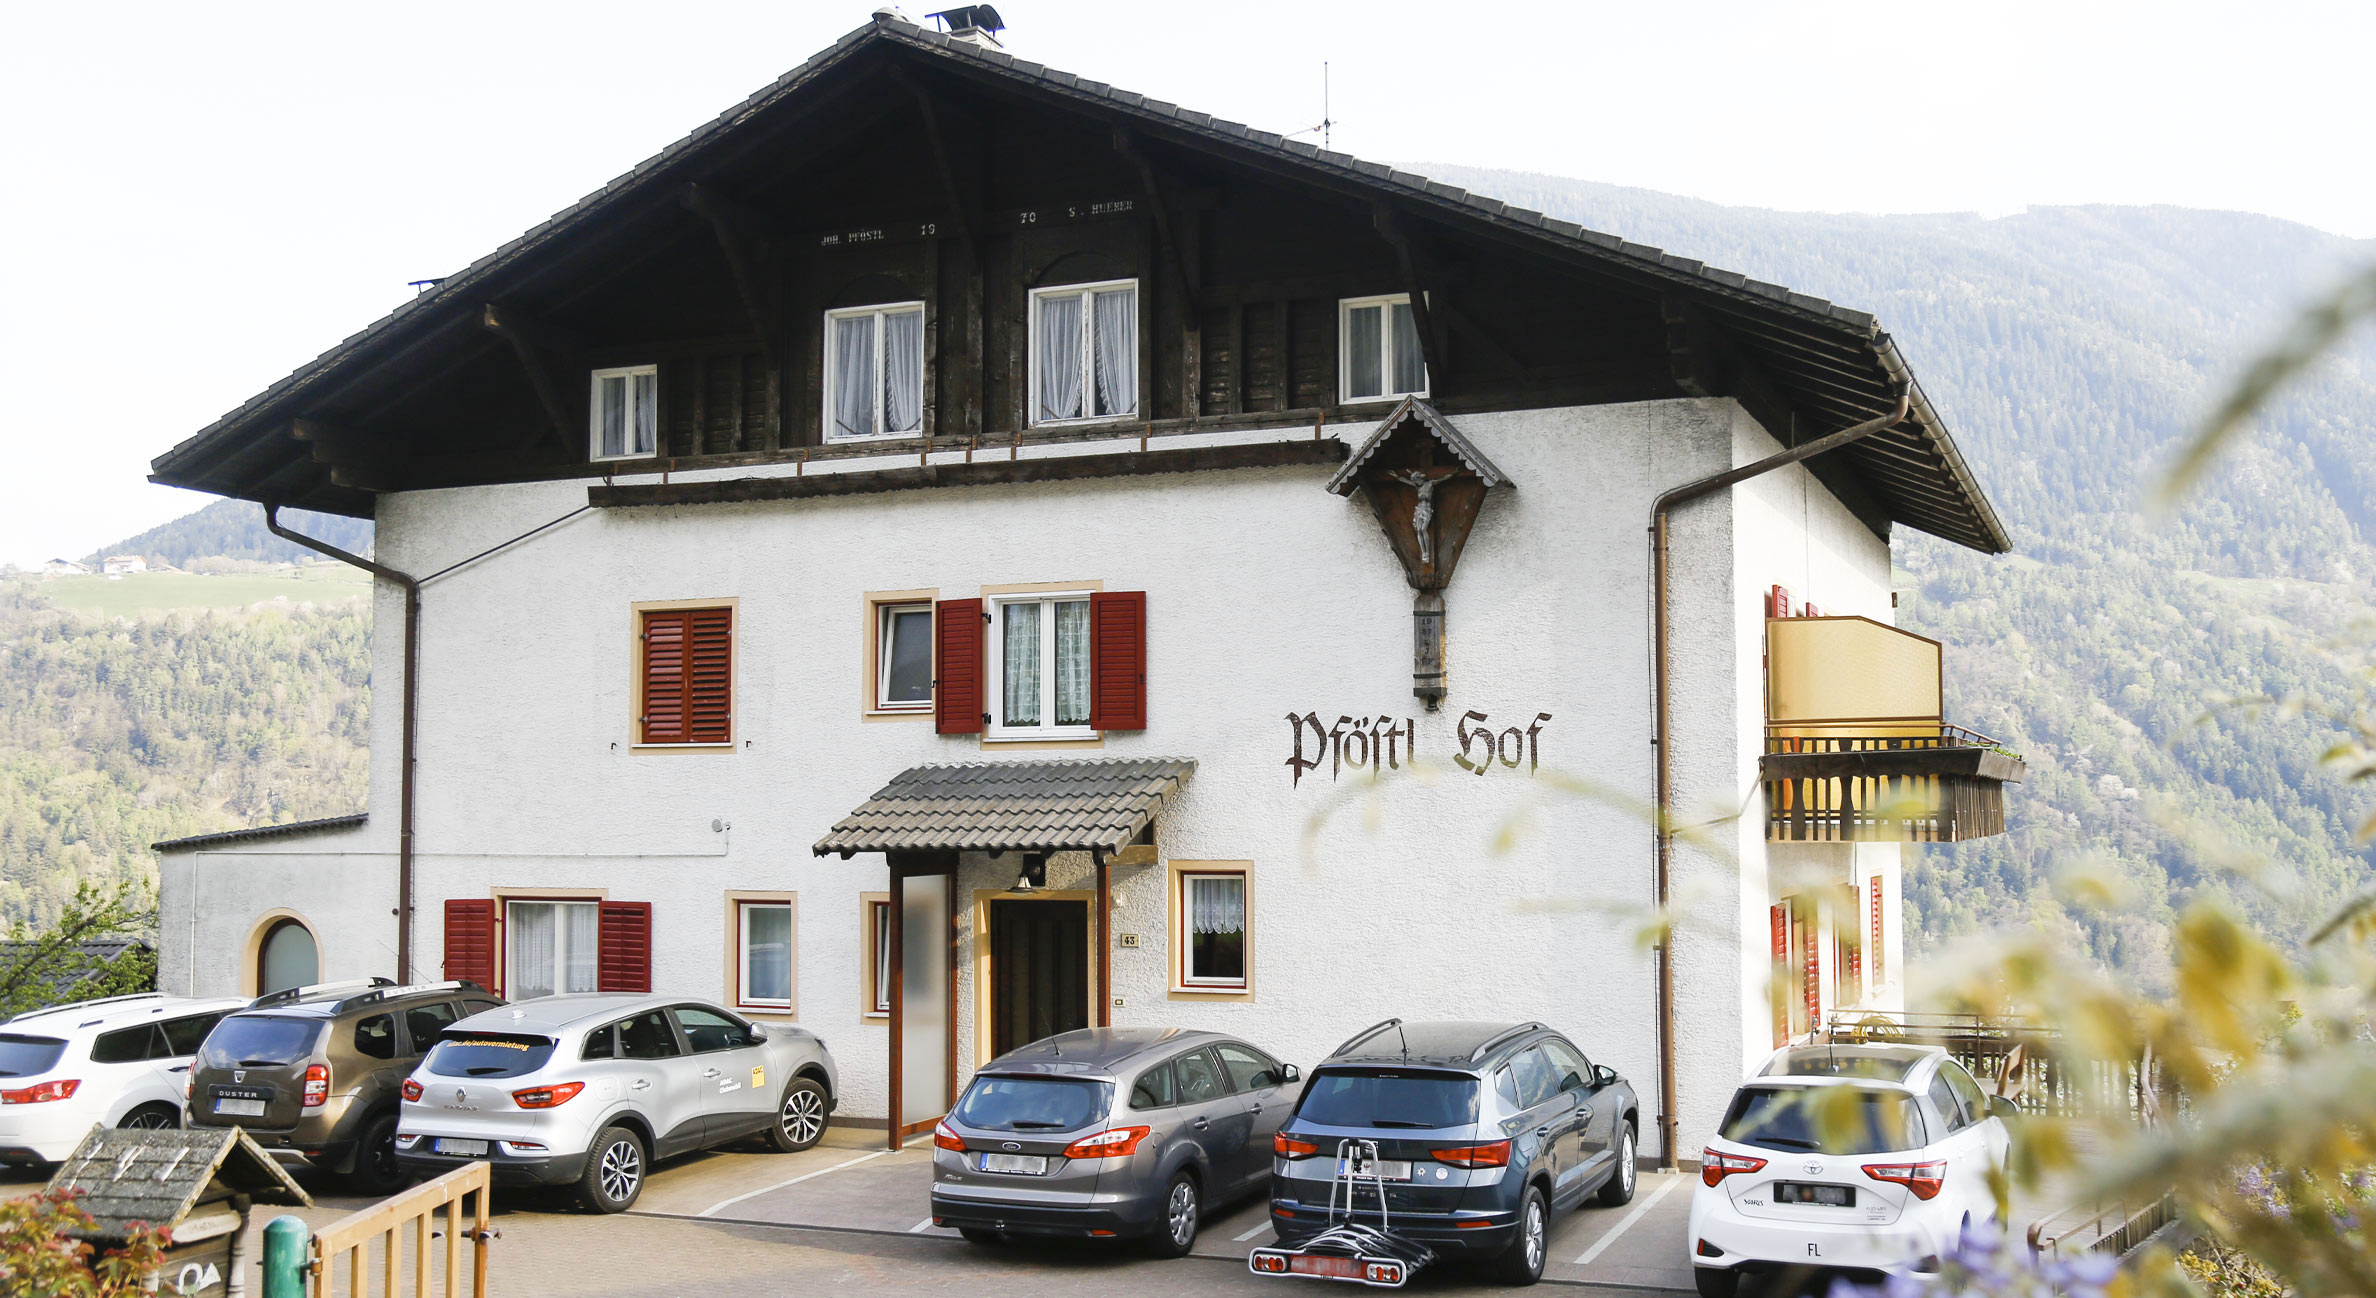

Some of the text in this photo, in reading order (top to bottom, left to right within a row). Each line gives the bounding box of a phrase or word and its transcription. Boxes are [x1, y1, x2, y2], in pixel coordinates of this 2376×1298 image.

[920, 223, 936, 235] 19
[1020, 212, 1036, 224] 70
[1284, 710, 1553, 790] Pföstl Hof
[1124, 936, 1135, 945] 43
[386, 985, 427, 997] DUSTER
[219, 1090, 257, 1098] DUSTER
[1743, 1198, 1764, 1206] YARIS
[1808, 1243, 1821, 1256] FL
